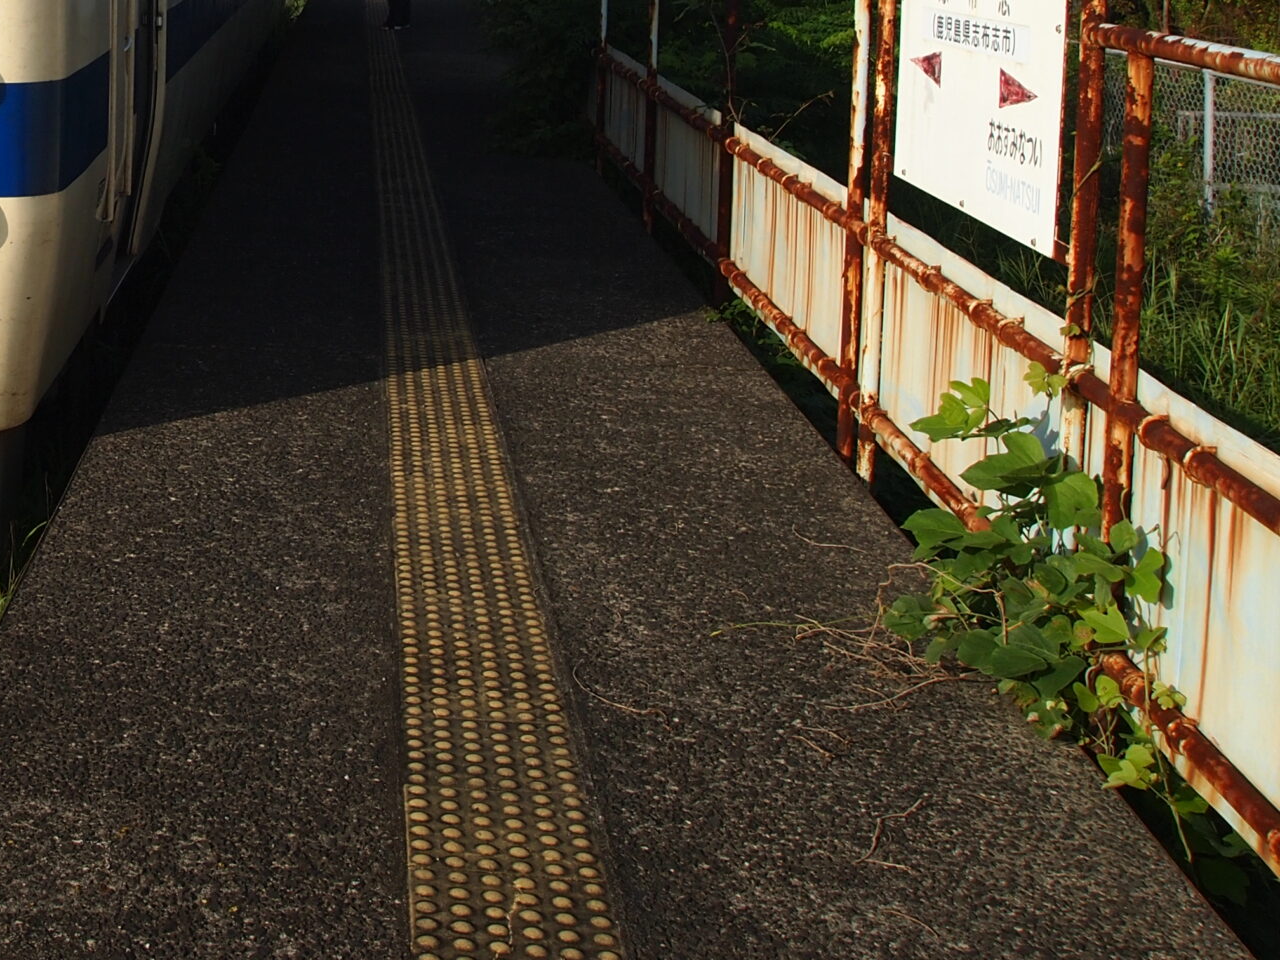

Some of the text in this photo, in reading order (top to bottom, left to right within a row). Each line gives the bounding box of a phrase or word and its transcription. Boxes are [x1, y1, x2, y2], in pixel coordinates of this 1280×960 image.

[986, 118, 1043, 169] おおすみなつい
